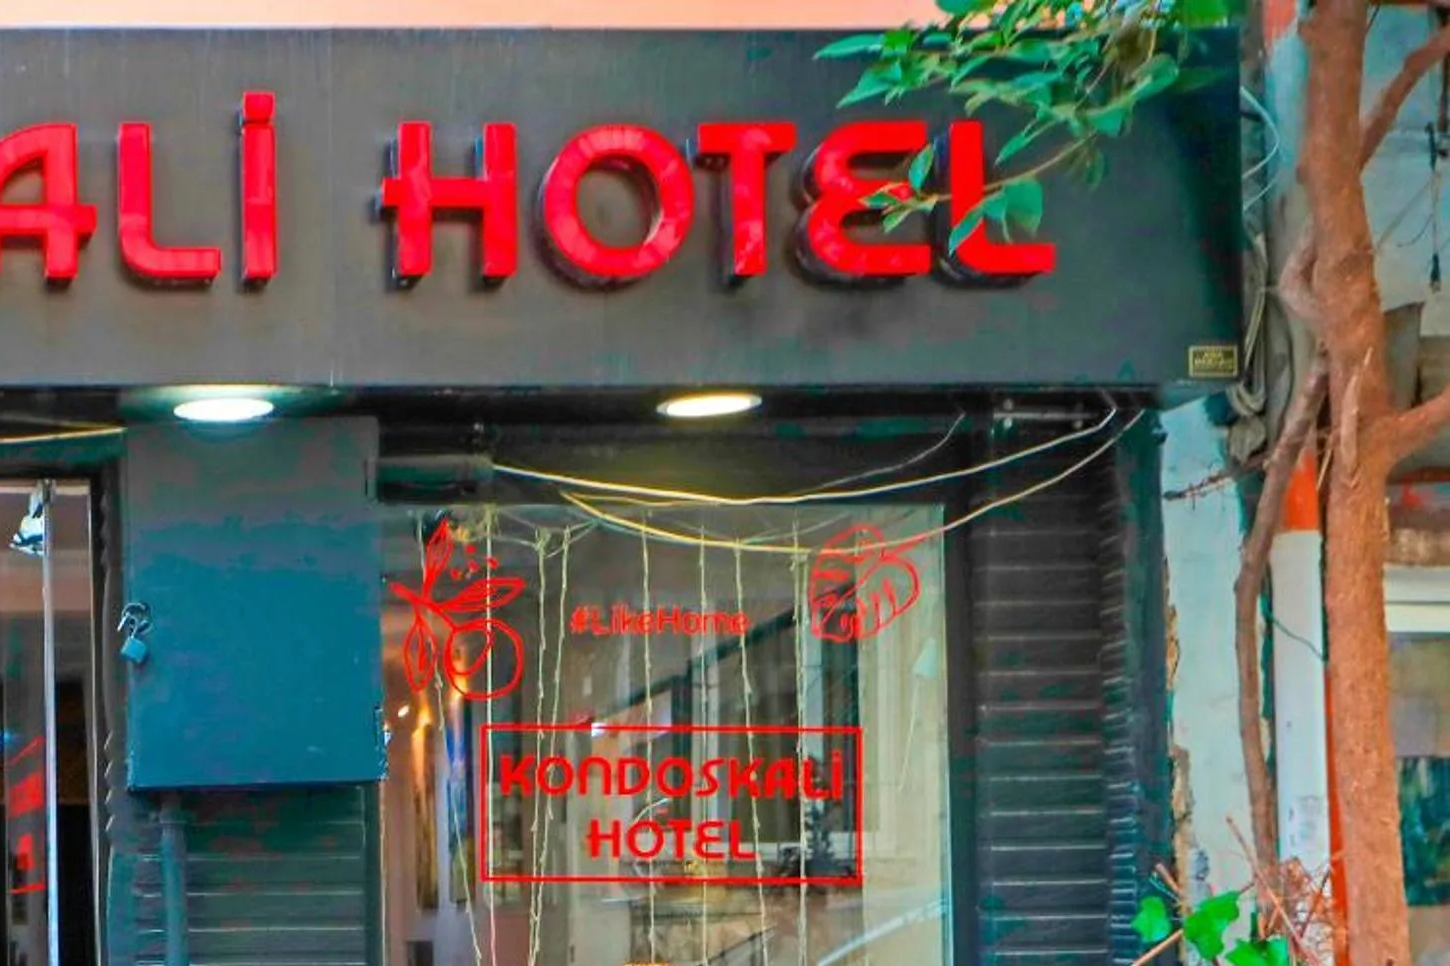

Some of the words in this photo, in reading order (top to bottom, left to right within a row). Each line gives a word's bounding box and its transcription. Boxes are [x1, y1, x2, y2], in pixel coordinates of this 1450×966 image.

[378, 120, 1056, 279] HOTEL
[570, 603, 749, 636] #LikeHome
[585, 818, 760, 863] HOTEL
